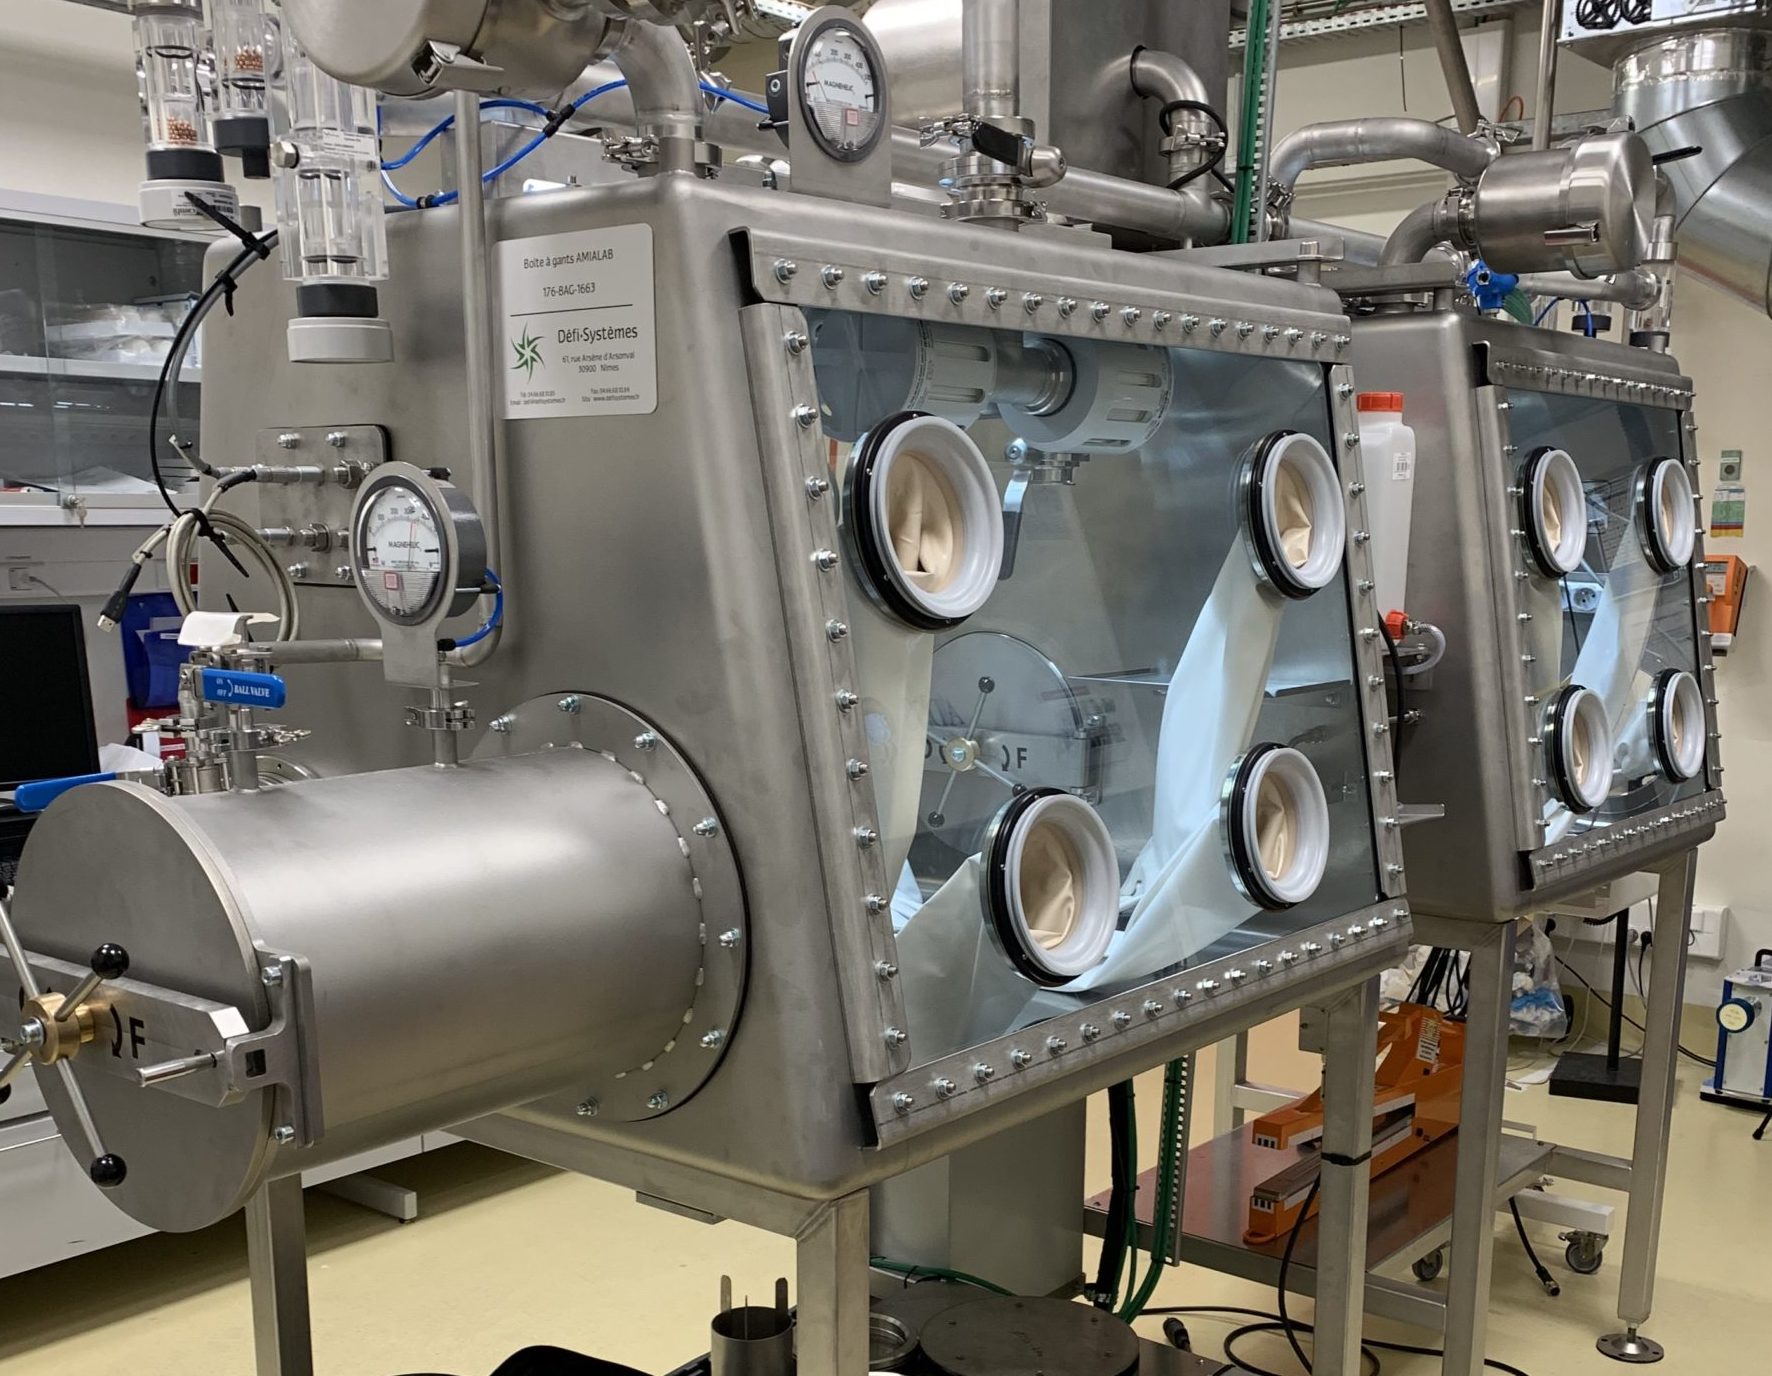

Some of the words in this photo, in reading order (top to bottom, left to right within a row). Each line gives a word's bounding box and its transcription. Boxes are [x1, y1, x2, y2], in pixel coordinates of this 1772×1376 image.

[552, 254, 575, 268] gants
[576, 249, 614, 263] AMIALAB
[542, 281, 596, 298] 176-BAG-1663
[234, 684, 250, 695] BALL
[250, 686, 271, 698] VALVE
[1016, 747, 1028, 769] F
[129, 1016, 145, 1060] F
